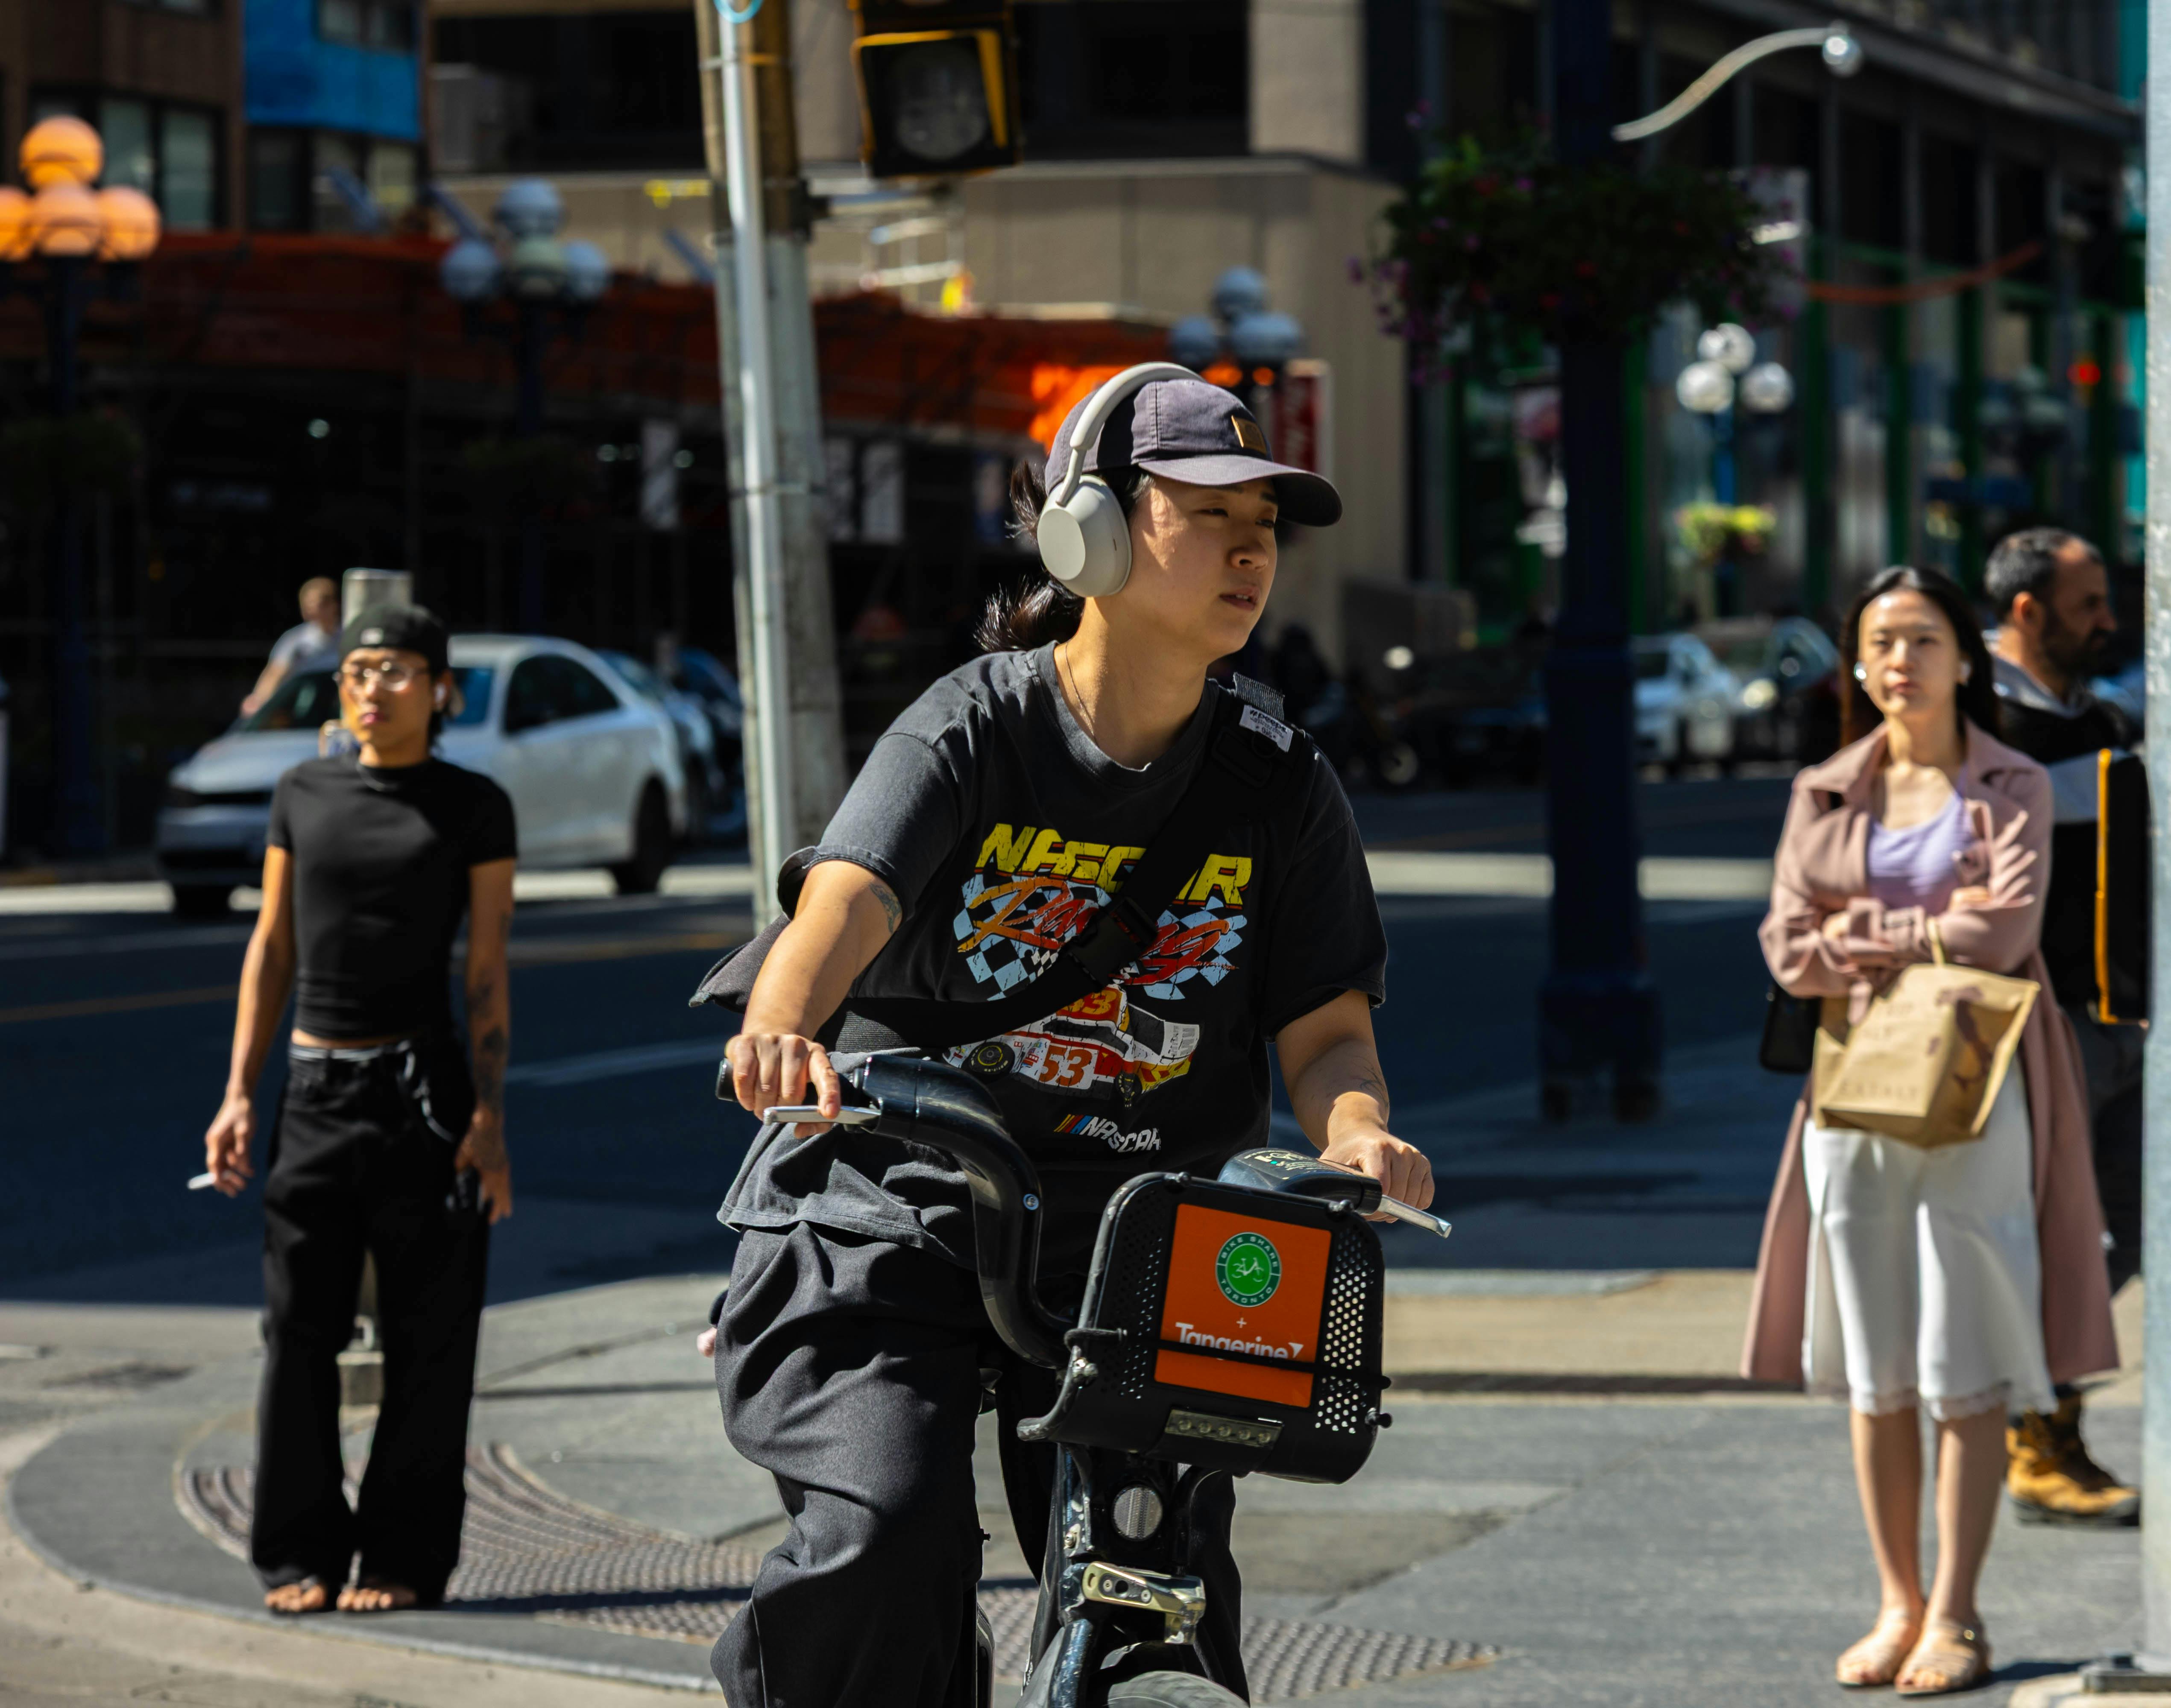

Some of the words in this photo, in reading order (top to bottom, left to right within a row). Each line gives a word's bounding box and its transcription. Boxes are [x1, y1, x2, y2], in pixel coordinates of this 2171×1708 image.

[974, 823, 1252, 910] NASCR
[1039, 1045, 1093, 1087] 53
[1221, 1237, 1243, 1259] BIKE
[1250, 1236, 1278, 1267] SHARE
[1221, 1278, 1272, 1303] TORONTO
